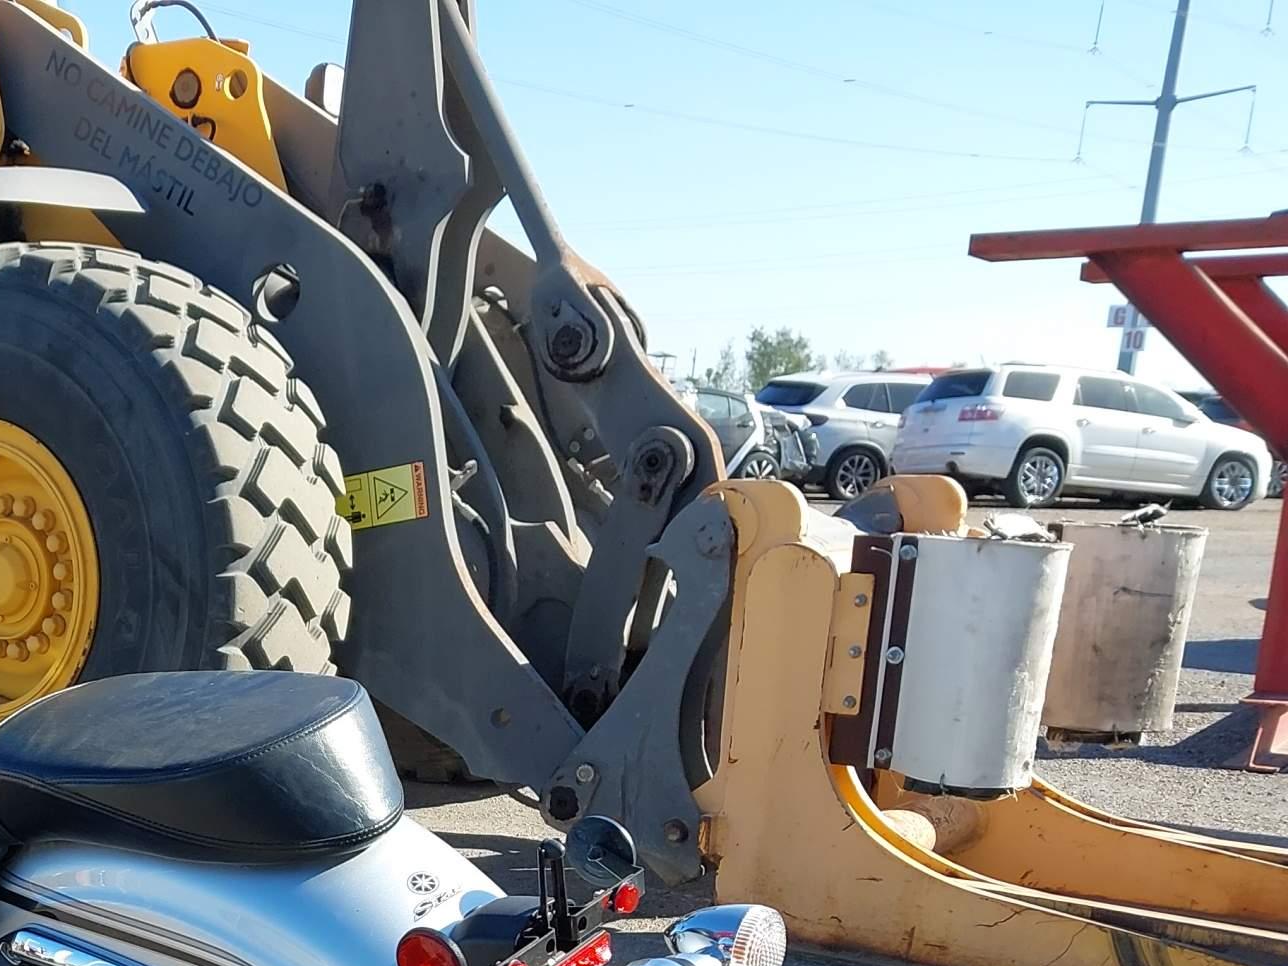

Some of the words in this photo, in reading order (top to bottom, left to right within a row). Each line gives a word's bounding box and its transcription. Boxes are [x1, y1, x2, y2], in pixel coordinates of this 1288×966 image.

[46, 50, 82, 86] NO
[86, 77, 174, 149] CAMINE
[174, 135, 262, 208] DEBAJO
[74, 117, 113, 160] DEL
[118, 145, 198, 217] MÁSTIL
[1124, 330, 1145, 350] 10
[415, 472, 426, 516] WARNING
